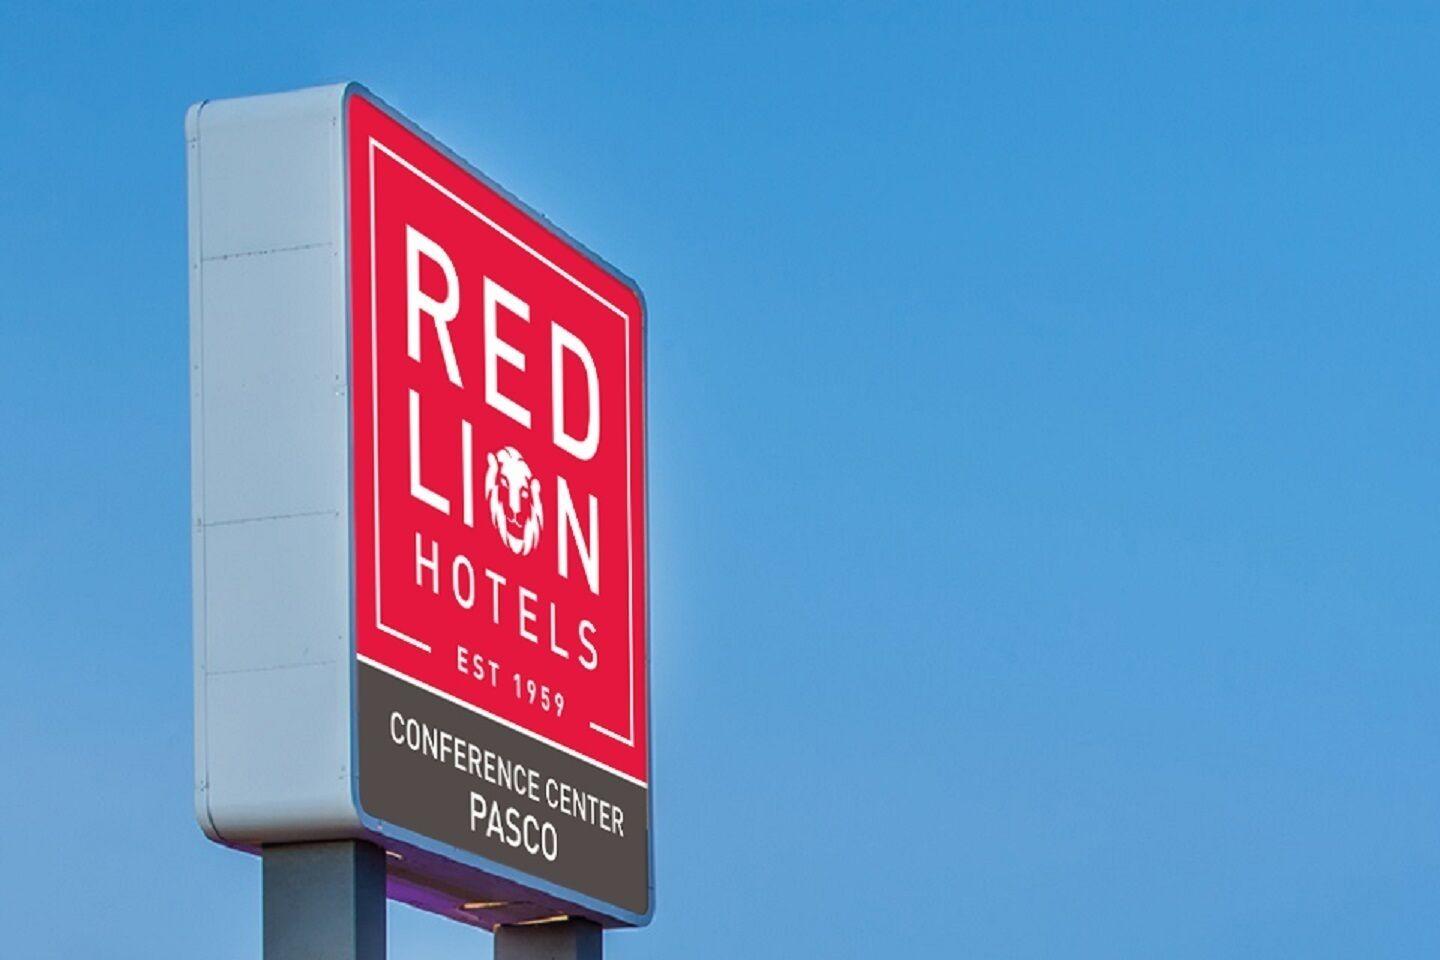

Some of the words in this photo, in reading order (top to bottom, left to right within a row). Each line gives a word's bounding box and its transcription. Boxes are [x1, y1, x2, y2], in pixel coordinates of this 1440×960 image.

[406, 223, 601, 462] RED
[414, 531, 599, 672] HOTELS
[456, 645, 500, 687] EST
[512, 672, 566, 718] 1959
[389, 710, 541, 803] CONFERENCE
[544, 777, 625, 838] CENTER
[469, 790, 559, 863] PASCO
